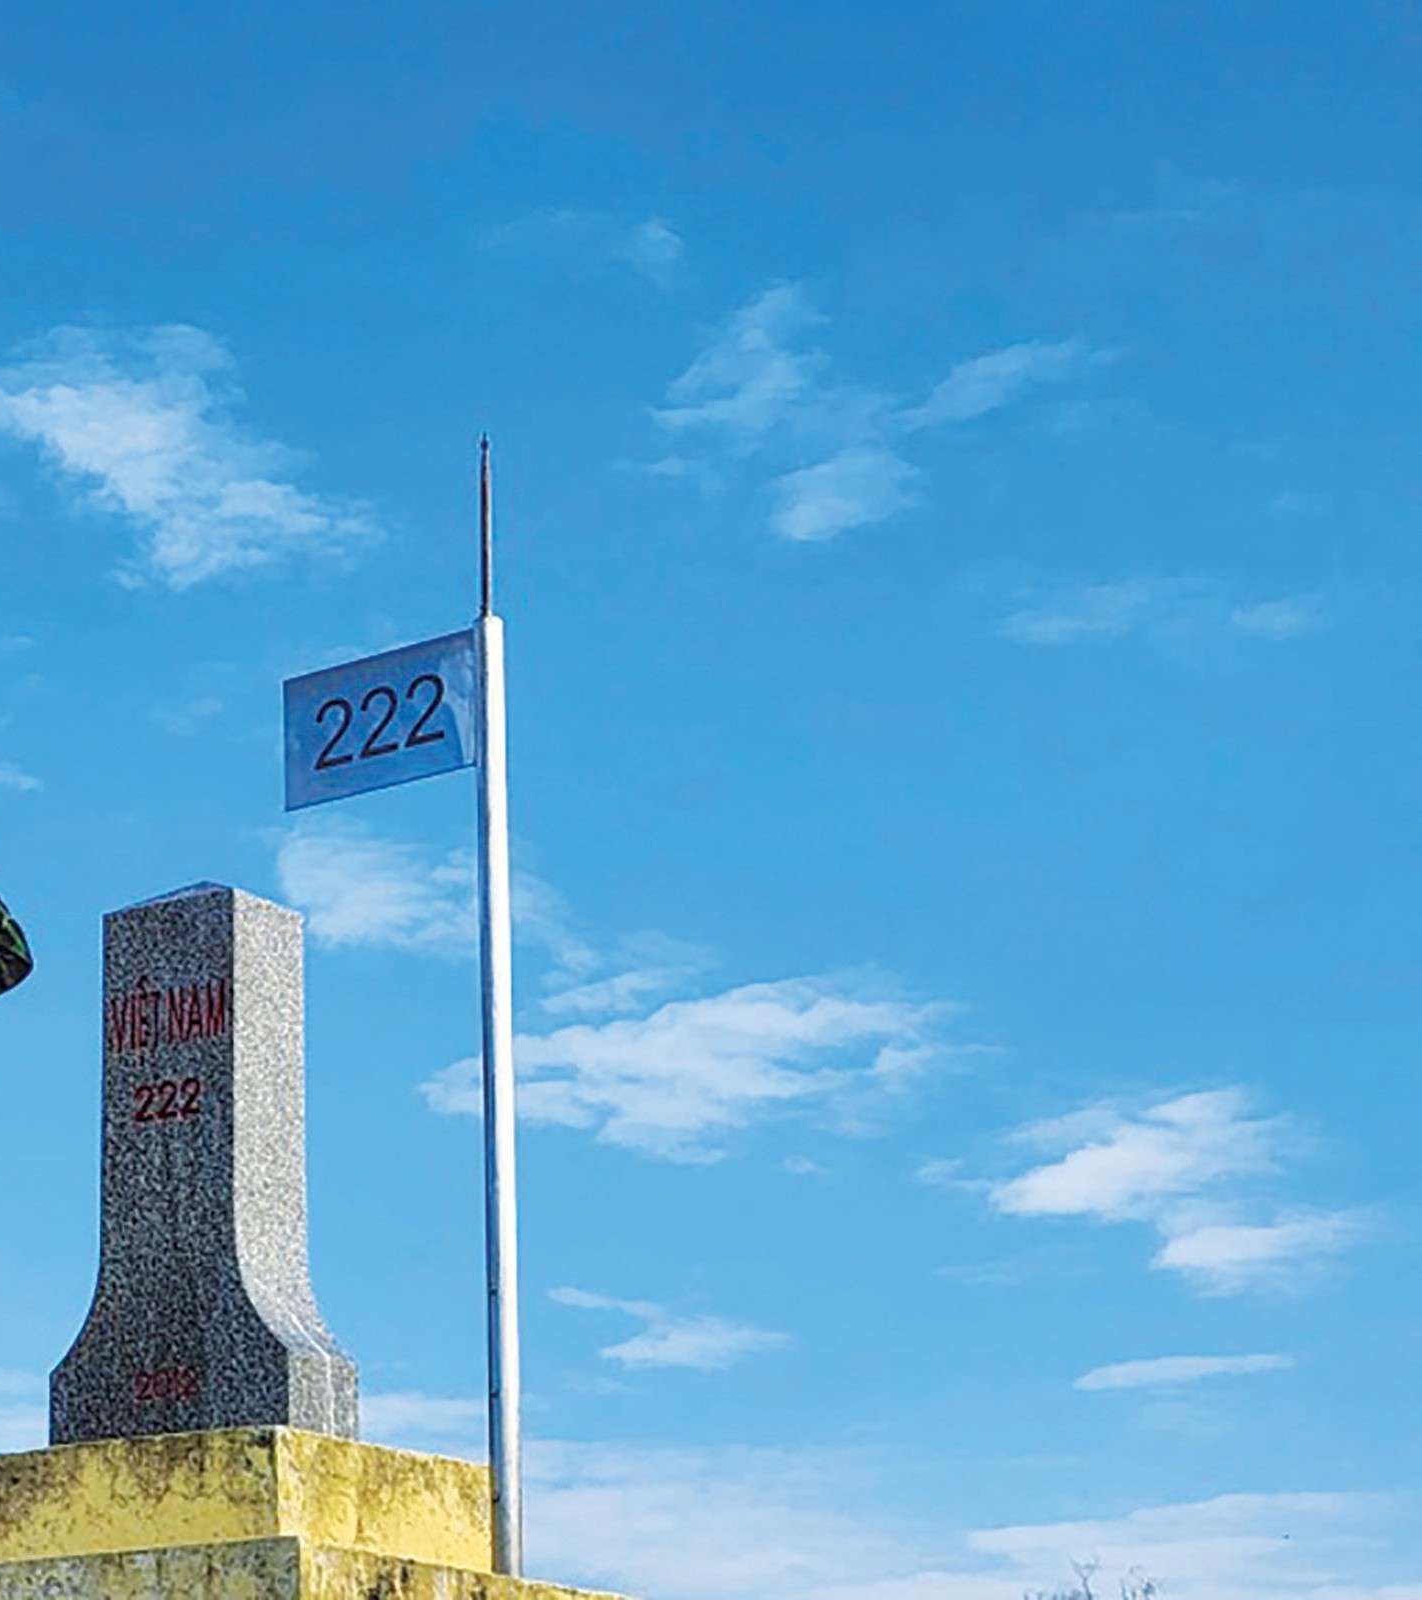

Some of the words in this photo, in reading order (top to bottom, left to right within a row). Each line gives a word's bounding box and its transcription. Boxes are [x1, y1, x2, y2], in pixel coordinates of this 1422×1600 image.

[314, 673, 445, 771] 222
[109, 975, 161, 1066] VIỆT
[166, 978, 226, 1044] NAM
[133, 1077, 201, 1122] 222
